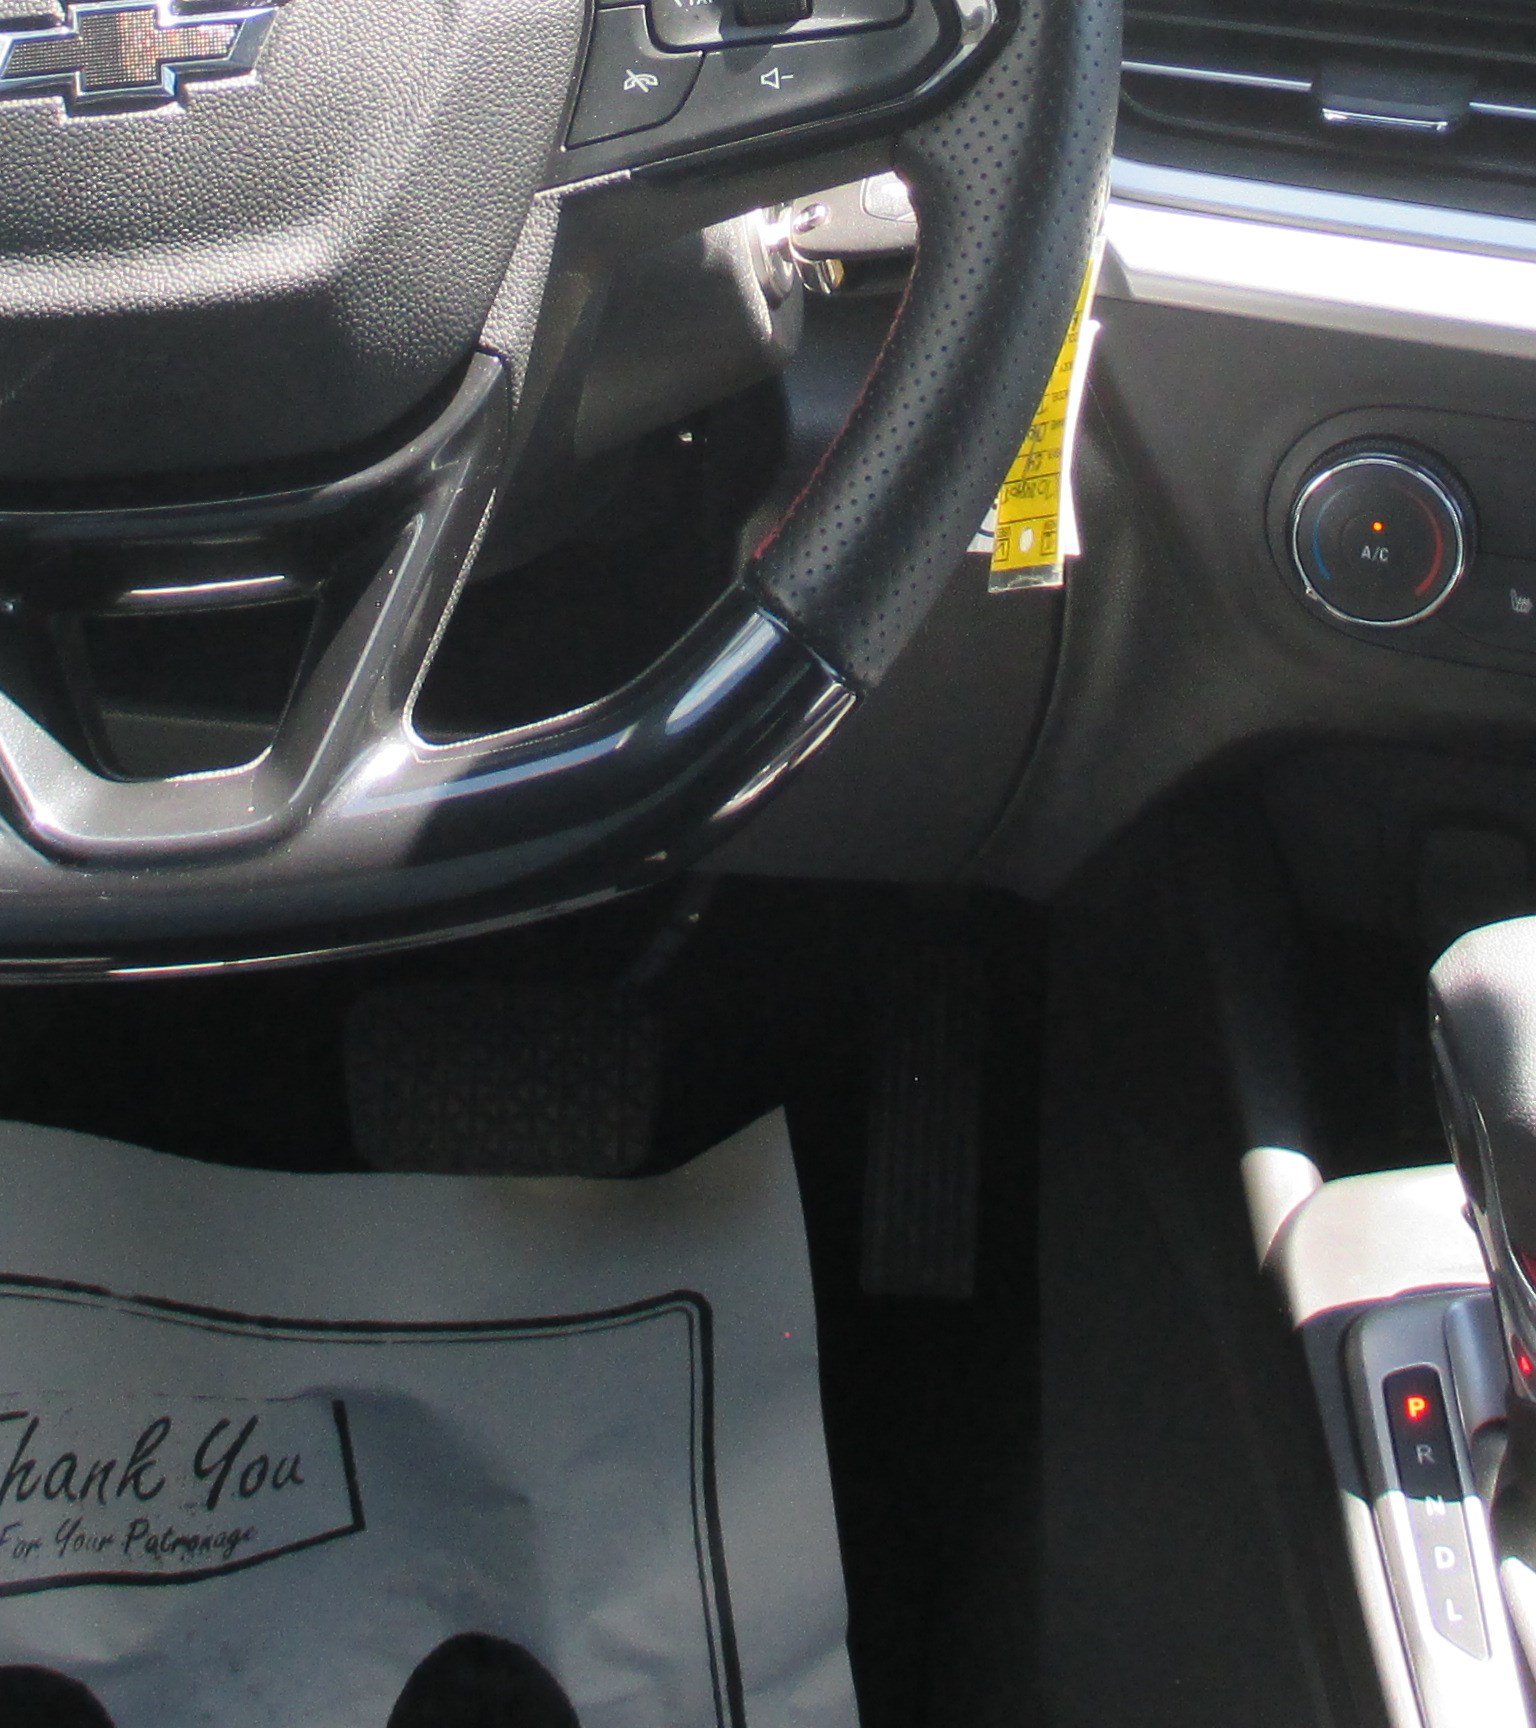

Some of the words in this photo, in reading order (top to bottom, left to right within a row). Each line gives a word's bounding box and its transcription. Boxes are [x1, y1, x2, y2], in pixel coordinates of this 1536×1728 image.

[1360, 544, 1390, 563] A/C
[1408, 1398, 1426, 1419] P
[190, 1416, 306, 1511] You
[1416, 1445, 1435, 1464] R
[1425, 1496, 1446, 1516] N
[55, 1519, 115, 1560] Your
[122, 1521, 258, 1562] Patronage
[1435, 1546, 1456, 1569] D
[1446, 1598, 1463, 1622] L
